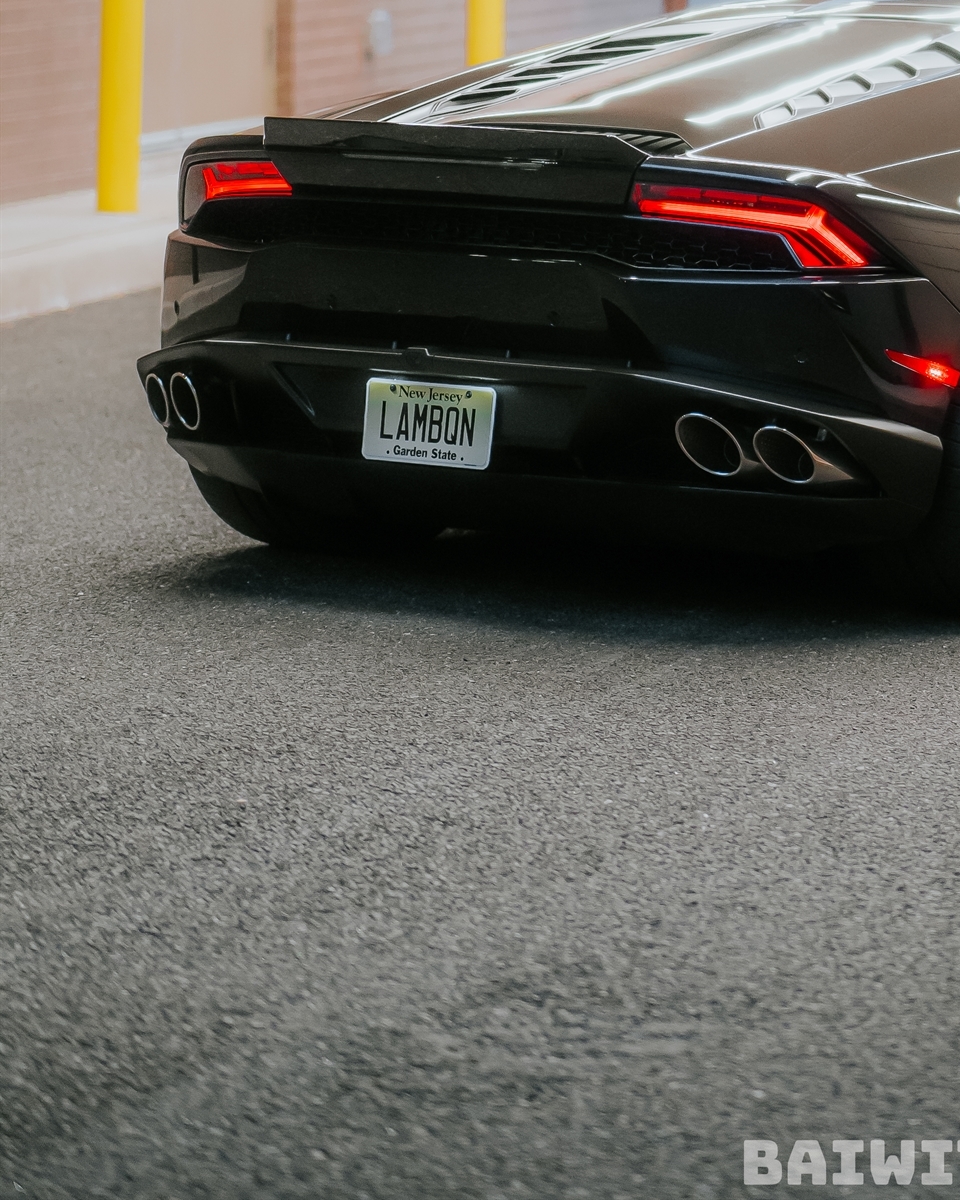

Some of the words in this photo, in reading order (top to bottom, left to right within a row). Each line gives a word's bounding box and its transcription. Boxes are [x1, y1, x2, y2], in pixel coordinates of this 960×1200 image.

[399, 385, 426, 399] New
[427, 388, 463, 405] Jersey
[380, 400, 476, 446] LAMBQN
[394, 444, 428, 458] Garden
[431, 448, 457, 461] State
